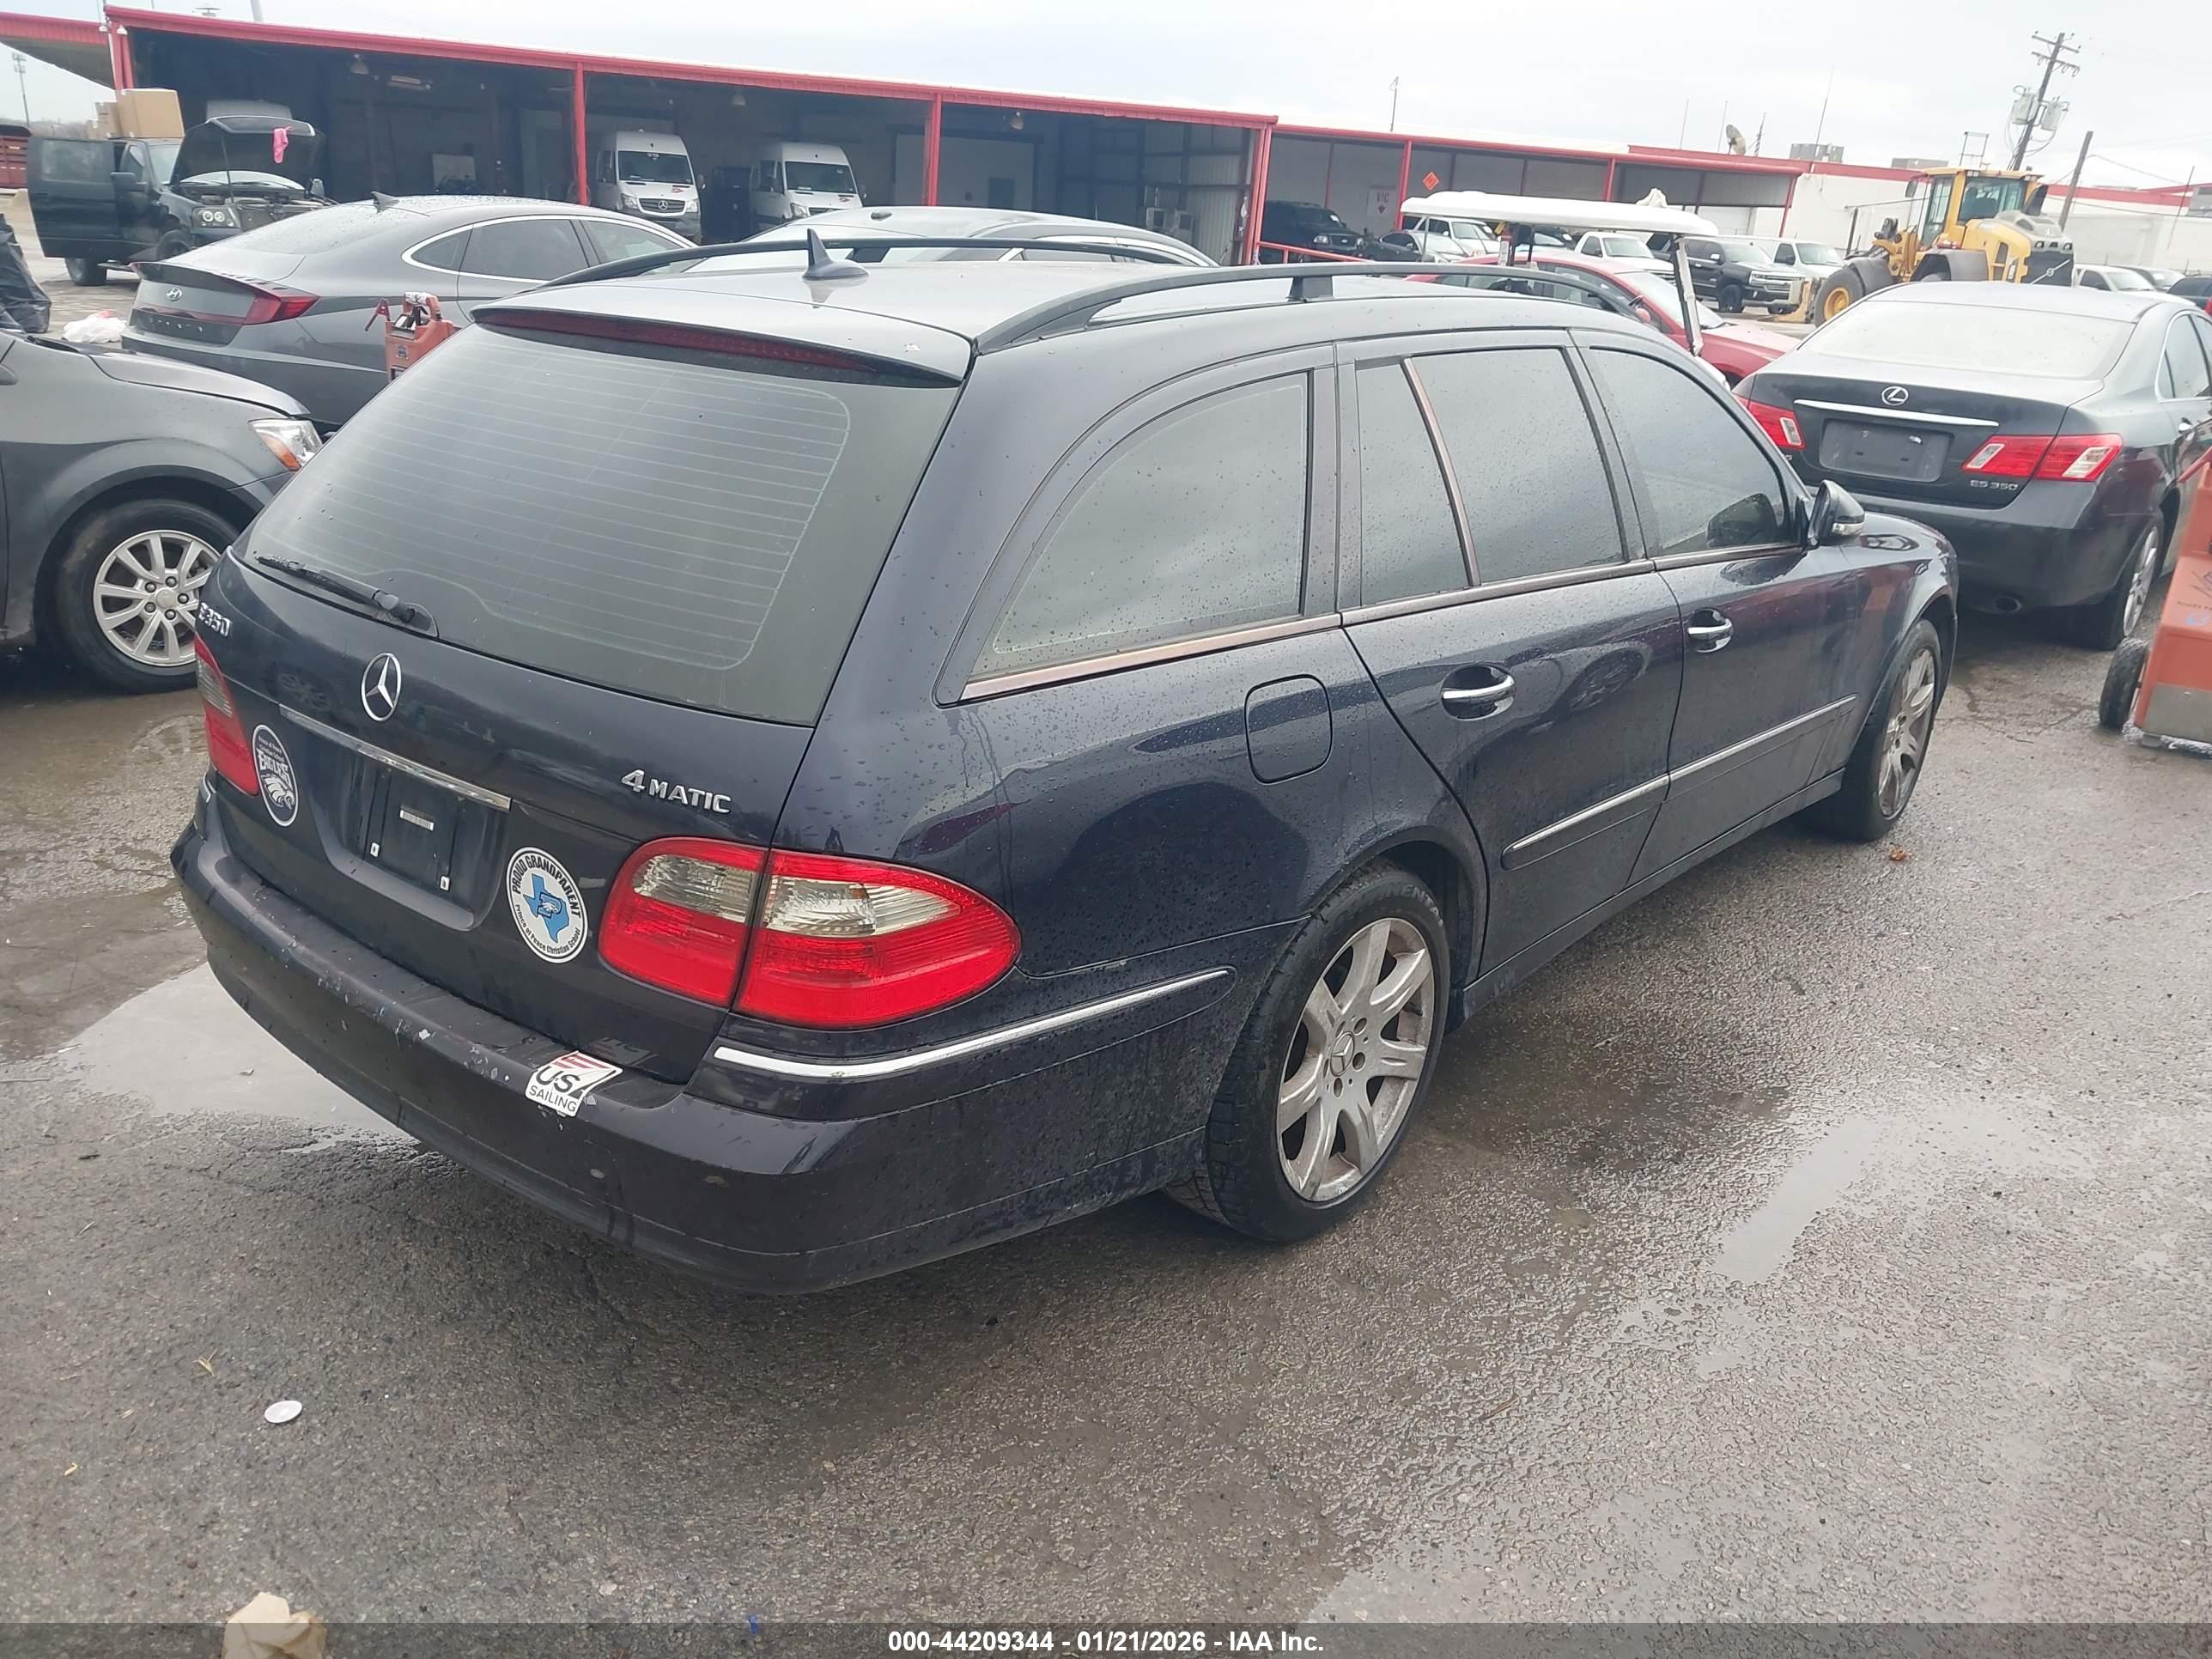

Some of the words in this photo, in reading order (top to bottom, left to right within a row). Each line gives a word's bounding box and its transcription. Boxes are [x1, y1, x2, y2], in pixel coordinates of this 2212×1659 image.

[256, 747, 294, 790] EAGLES
[512, 859, 528, 895] PROUD
[525, 854, 581, 919] GRANDPARENT
[515, 904, 527, 928] Prince
[568, 927, 580, 948] School
[529, 1085, 577, 1112] SAILING
